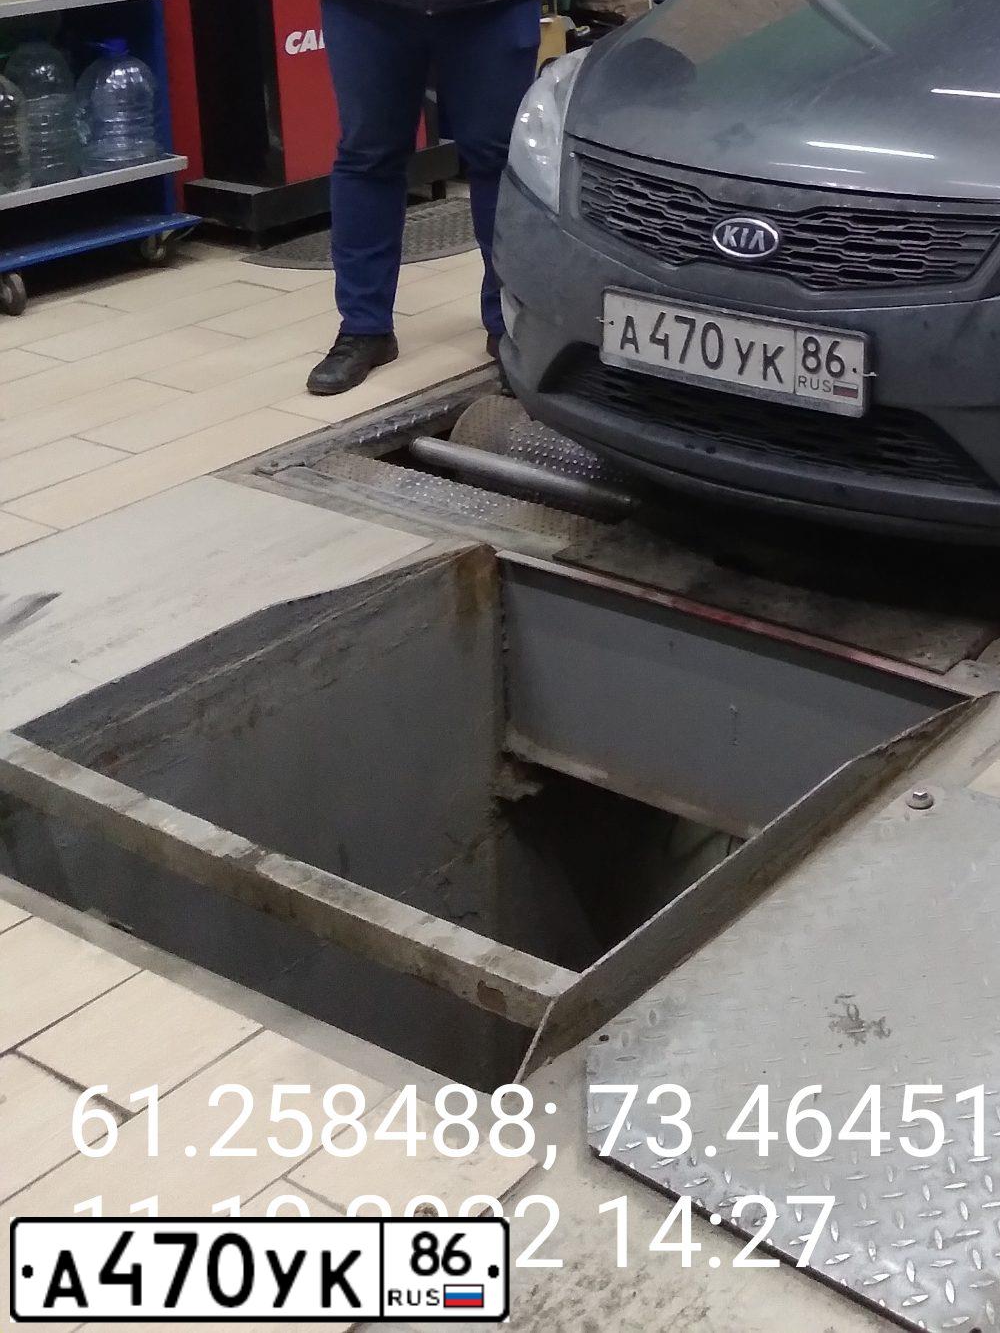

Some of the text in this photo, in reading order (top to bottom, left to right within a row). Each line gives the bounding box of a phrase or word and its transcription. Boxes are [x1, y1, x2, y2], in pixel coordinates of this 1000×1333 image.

[722, 224, 767, 253] KIA
[801, 336, 846, 378] 86
[797, 375, 832, 394] RUS
